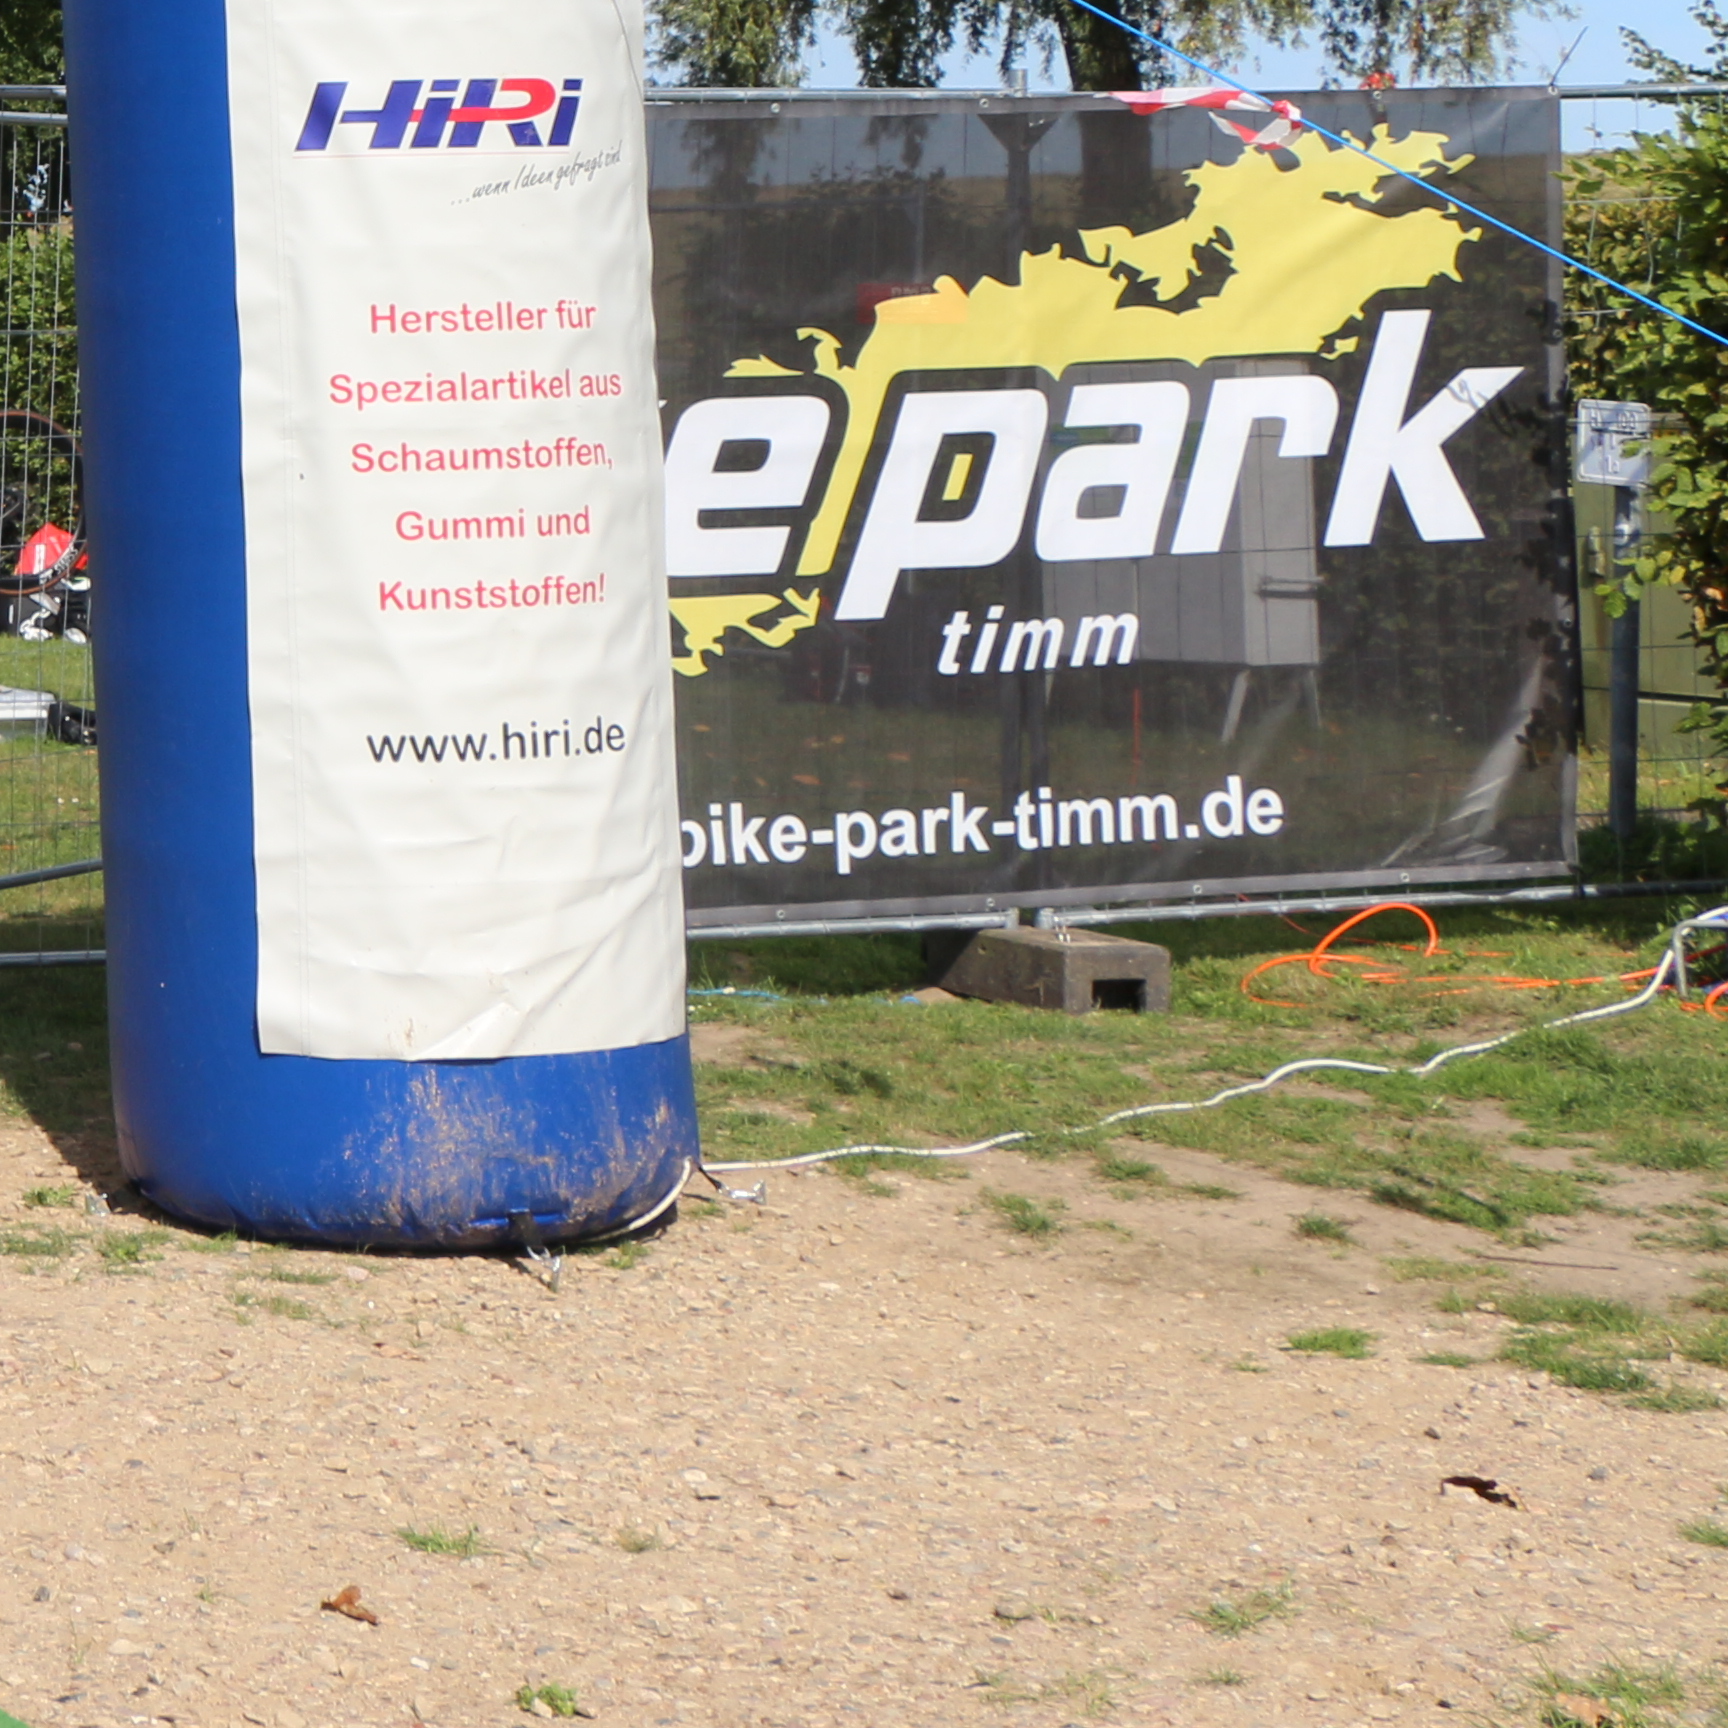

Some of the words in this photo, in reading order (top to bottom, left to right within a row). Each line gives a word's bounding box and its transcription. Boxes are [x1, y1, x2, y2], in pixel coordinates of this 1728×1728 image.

[369, 301, 546, 335] Hersteller
[554, 299, 598, 330] für
[328, 368, 572, 409] Spezialartikel
[578, 374, 622, 398] aus
[350, 436, 613, 475] Schaumstoffen,
[395, 508, 526, 542] Gummi
[537, 505, 591, 538] und
[378, 572, 606, 612] Kunststoffen!
[937, 604, 1141, 676] timm
[366, 715, 627, 764] www.hiri.de
